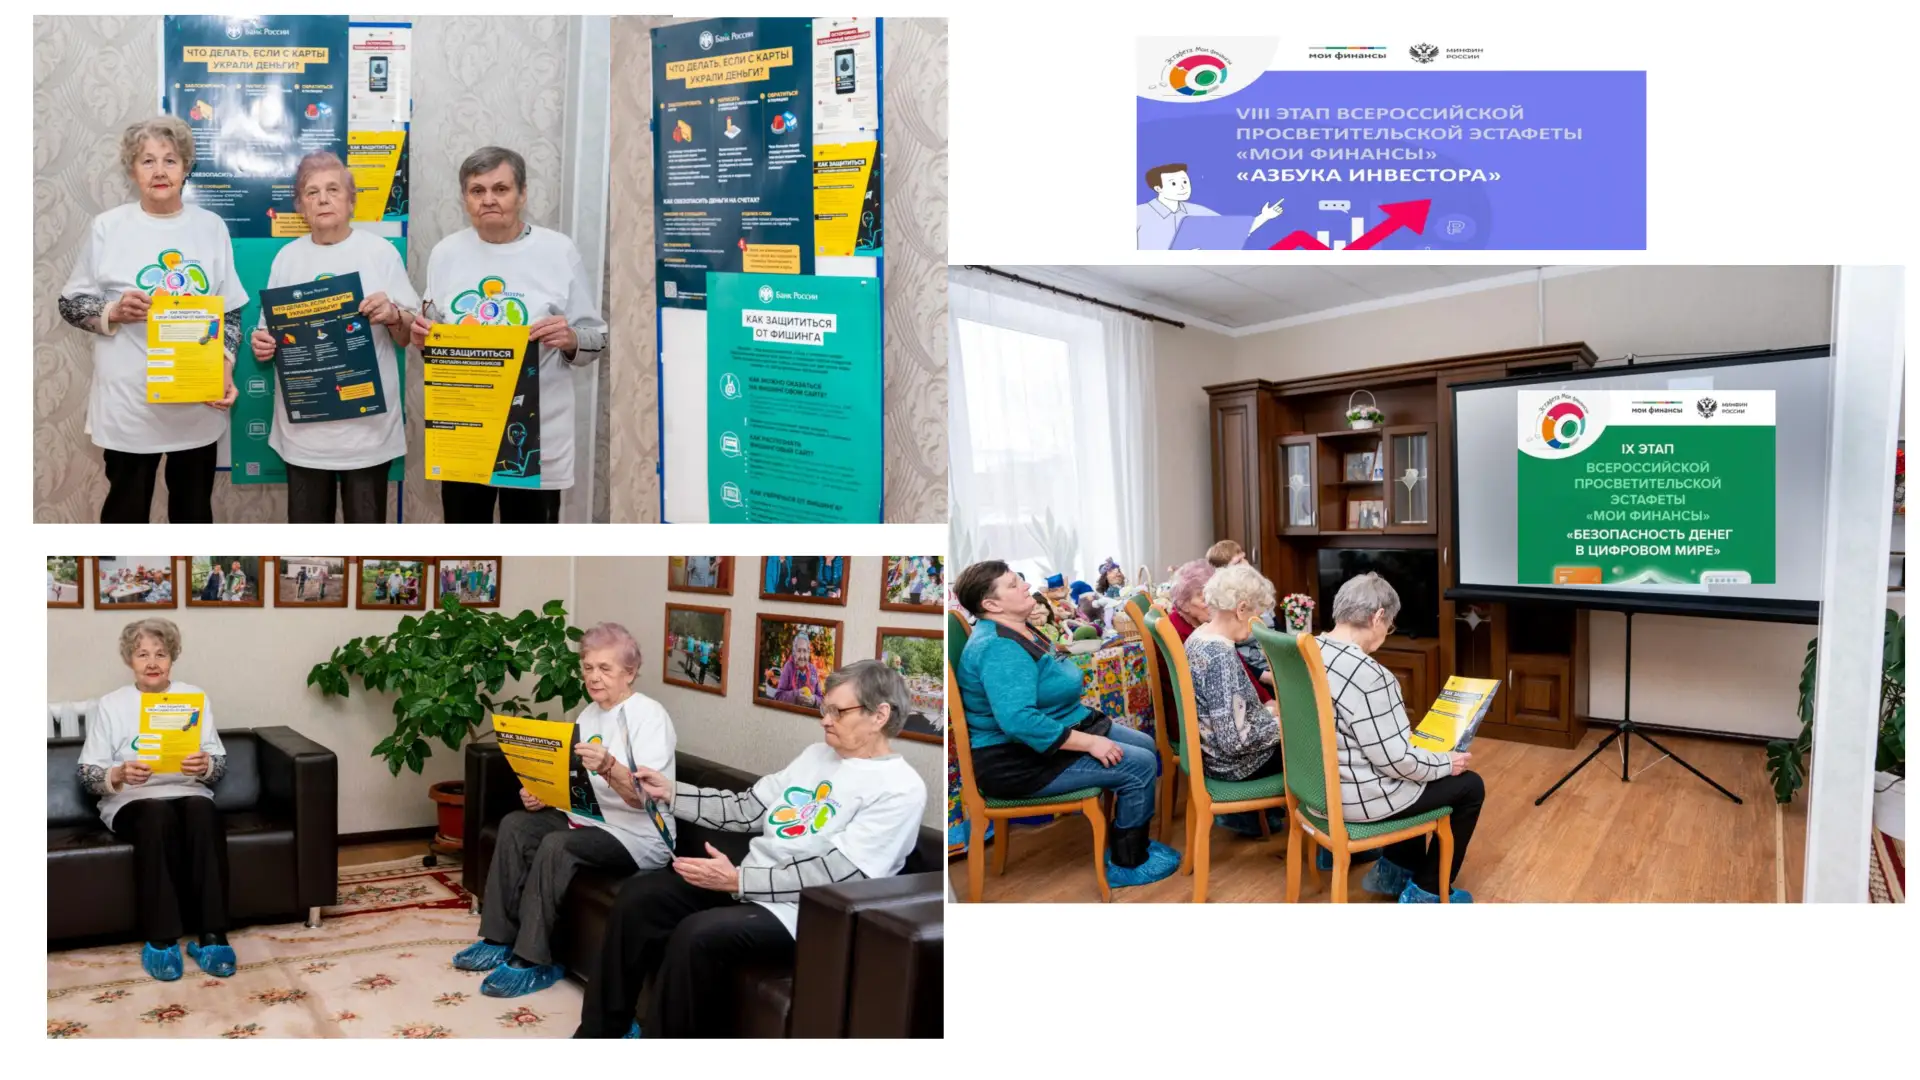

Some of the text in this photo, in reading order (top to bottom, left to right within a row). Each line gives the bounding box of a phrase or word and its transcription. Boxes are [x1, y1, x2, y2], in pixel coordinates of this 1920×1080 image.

[263, 27, 290, 36] России
[715, 31, 754, 43] Банк России
[186, 49, 325, 58] ЧТО ДЕЛАТЬ, ЕСЛИ С КАРТЫ
[1334, 52, 1387, 60] финансы
[213, 61, 300, 70] УКРАЛИ ДЕНЬГИ?
[669, 50, 789, 73] ЧТО ДЕЛАТЬ, ЕСЛИ С КАРТЫ
[690, 68, 764, 84] УКРАЛИ ДЕНЬГИ?
[1236, 104, 1524, 120] VIII ЭТАП ВСЕРОССИЙСКОЙ
[1236, 125, 1583, 140] ПРОСВЕТИТЕЛЬСКОЙ ЭСТАФЕТЫ
[1236, 148, 1437, 160] «МОИ ФИНАНСЫ»
[829, 159, 865, 167] ЗАЩИТИТЬСЯ
[1236, 169, 1501, 182] «АЗБУКА ИНВЕСТОРА»
[776, 291, 818, 300] Банк России
[286, 303, 310, 311] ДЕЛАТЬ,
[332, 294, 352, 302] КАРТЫ
[289, 304, 338, 317] УКРАЛИ ДЕНЬГИ?
[746, 315, 832, 328] КАК ЗАЩИТИТЬСЯ
[756, 329, 821, 342] ОТ ФИШИНГА
[431, 348, 511, 358] КАК ЗАЩИТИТЬСЯ
[1648, 406, 1683, 415] финансы
[1621, 444, 1674, 454] IX ЭТАП
[1586, 461, 1710, 473] ВСЕРОССИЙСКОЙ
[1574, 477, 1722, 489] ПРОСВЕТИТЕЛЬСКОЙ
[1610, 494, 1686, 505] ЭСТАФЕТЫ
[1586, 510, 1710, 521] «МОИ ФИНАНСЫ»
[1566, 529, 1733, 541] «БЕЗОПАСНОСТЬ ДЕНЕГ
[1575, 545, 1720, 558] В ЦИФРОВОМ МИРЕ»
[515, 734, 560, 746] ЗАЩИТИТЬСЯ
